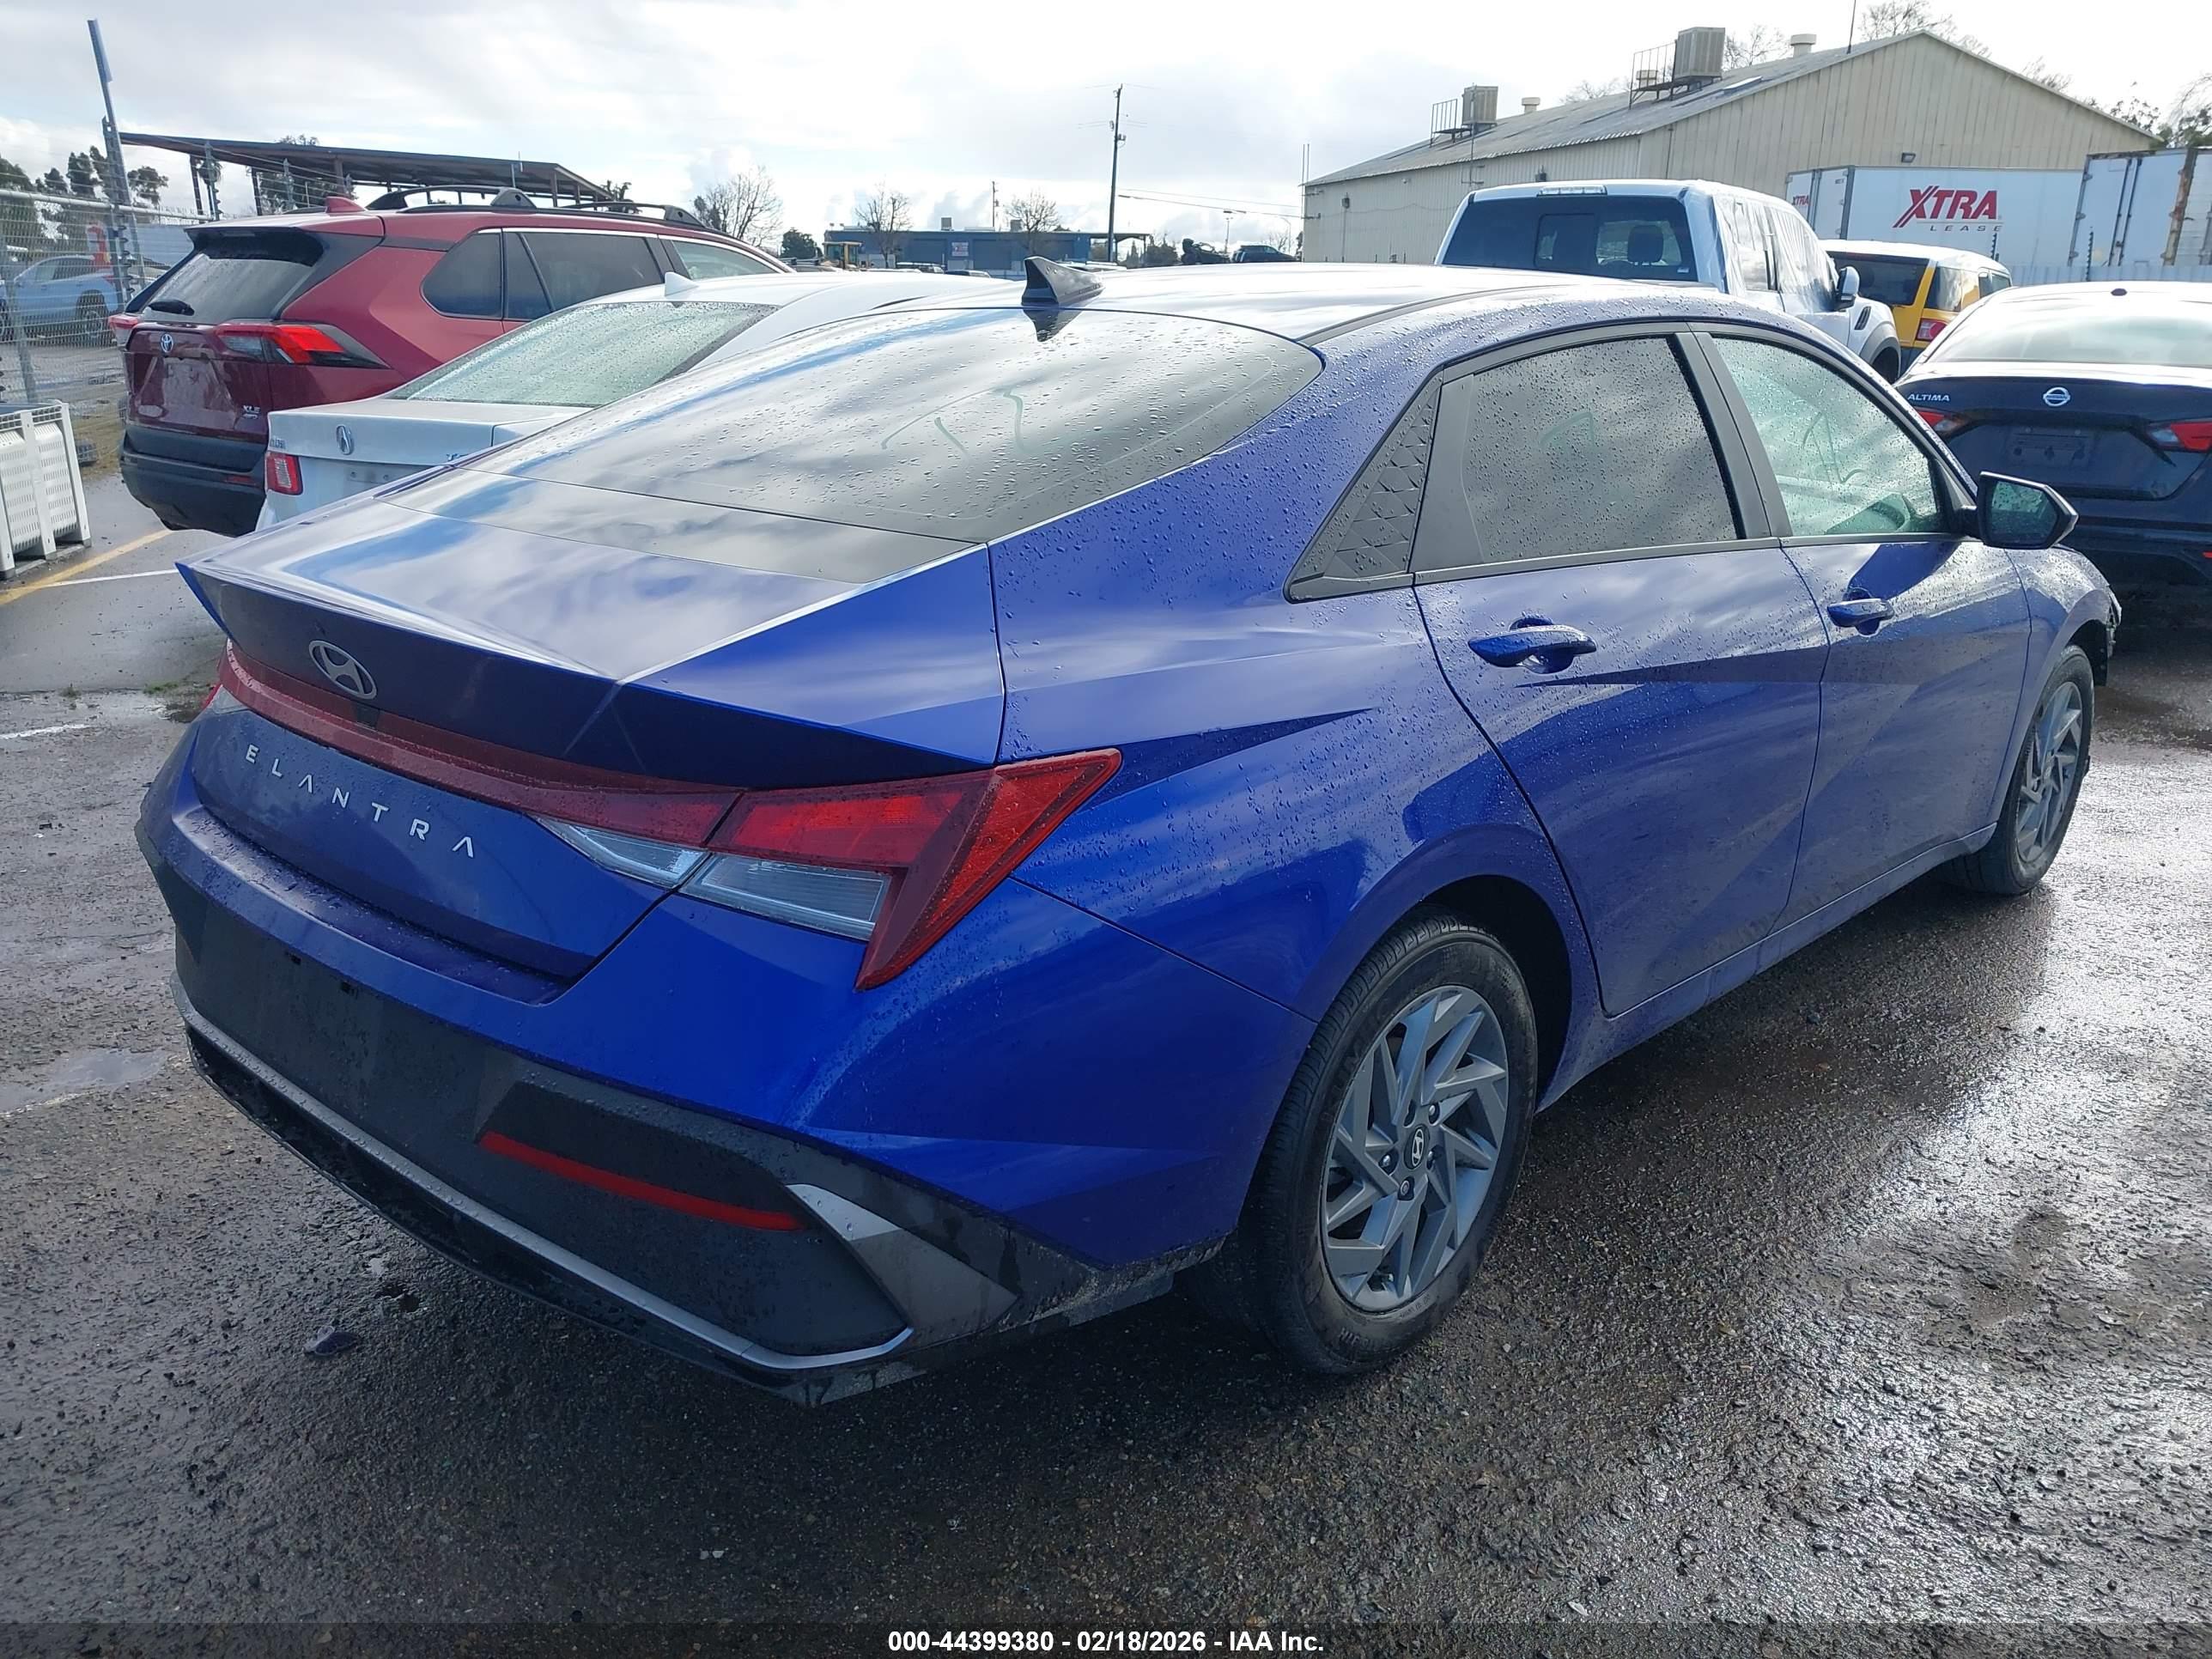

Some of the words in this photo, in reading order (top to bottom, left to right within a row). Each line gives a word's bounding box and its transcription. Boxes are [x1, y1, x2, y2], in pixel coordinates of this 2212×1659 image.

[1893, 185, 1997, 228] XTRA
[1907, 393, 1950, 402] ALTIMA
[246, 744, 474, 858] ELANTRA
